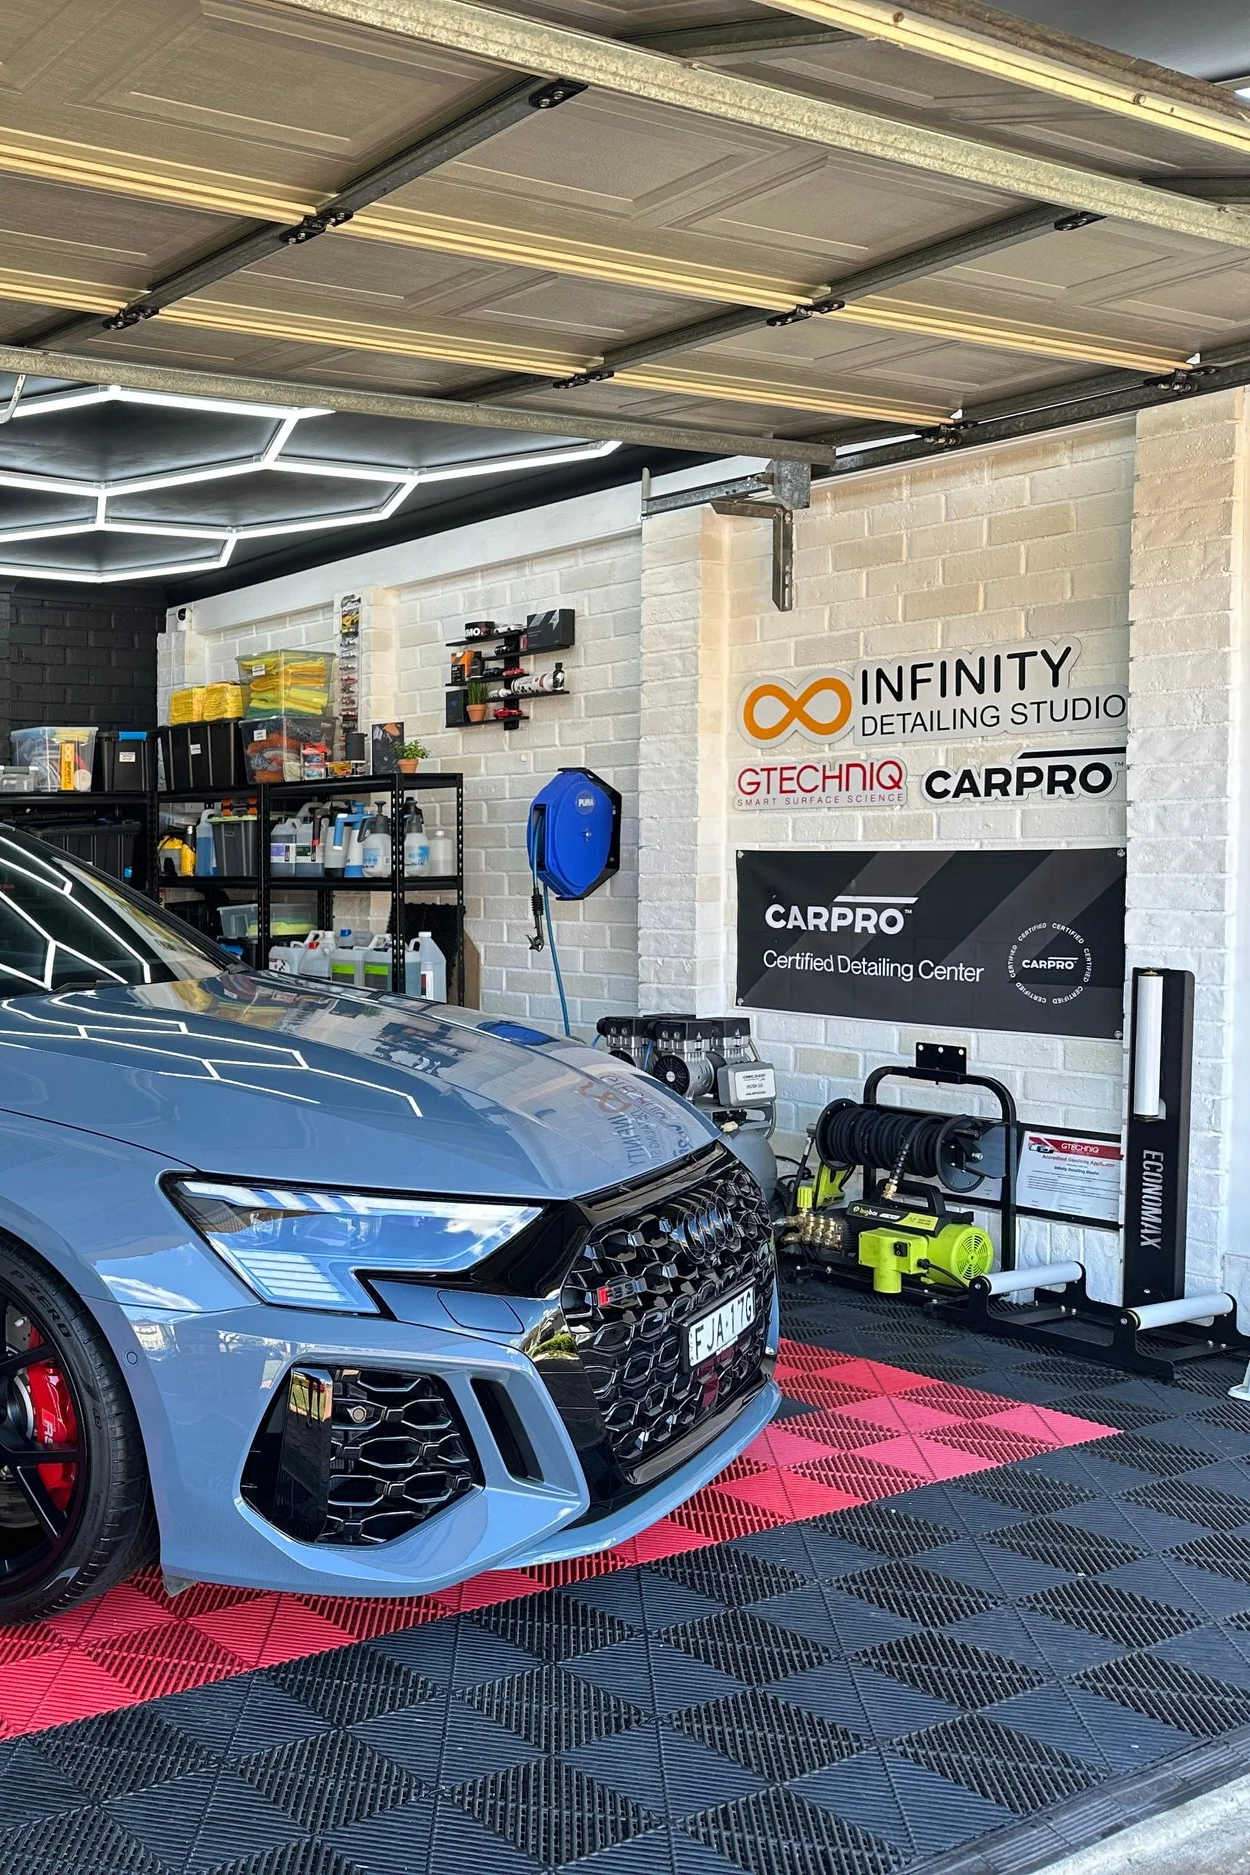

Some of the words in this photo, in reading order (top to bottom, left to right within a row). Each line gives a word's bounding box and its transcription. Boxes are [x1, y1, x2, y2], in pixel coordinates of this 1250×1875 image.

[860, 646, 1072, 705] INFINITY
[861, 705, 1000, 737] DETAILING
[1010, 692, 1126, 727] STUDIO
[737, 760, 904, 796] GTECHNIQ
[578, 798, 594, 808] PUMA
[737, 797, 777, 807] SMART
[784, 795, 841, 805] SURFACE
[847, 793, 904, 803] SCIENCE
[1017, 922, 1047, 942] CERTIFIED
[1051, 922, 1084, 944] CERTIFIED
[763, 949, 834, 973] Certified
[838, 955, 914, 982] Detailing
[918, 959, 984, 983] Center
[1007, 944, 1018, 979] CERTIFIED
[1083, 948, 1092, 983] CERTIFIED
[1015, 981, 1047, 1004] CERTIFIED
[1052, 985, 1084, 1005] CERTIFIED
[1061, 1142, 1099, 1154] GTECHNIQ
[1140, 1149, 1164, 1250] ECONOMAX
[26, 1284, 72, 1338] ZERO
